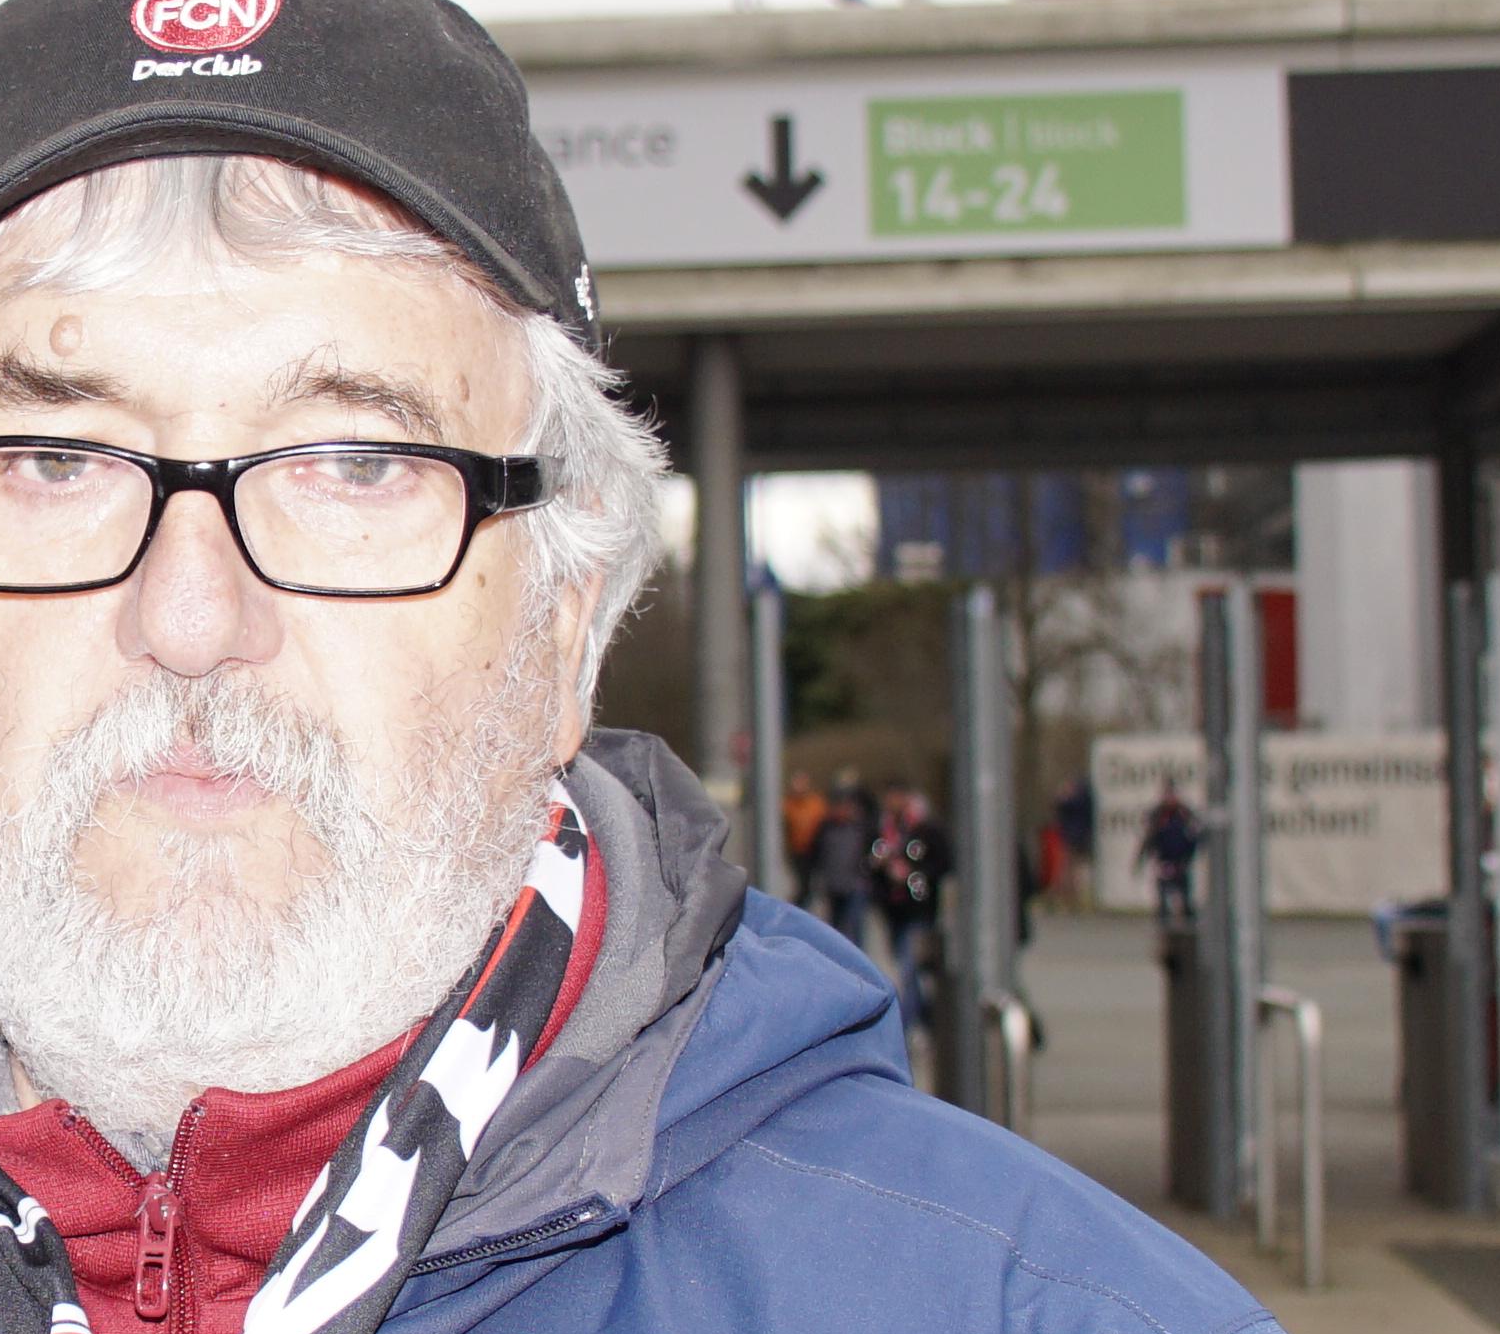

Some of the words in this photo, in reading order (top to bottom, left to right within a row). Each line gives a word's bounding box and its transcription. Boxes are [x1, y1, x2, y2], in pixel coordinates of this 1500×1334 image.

[131, 59, 193, 81] Der
[191, 53, 263, 77] Club
[538, 122, 679, 169] ance
[883, 115, 994, 157] Block
[887, 163, 1071, 225] 14-24
